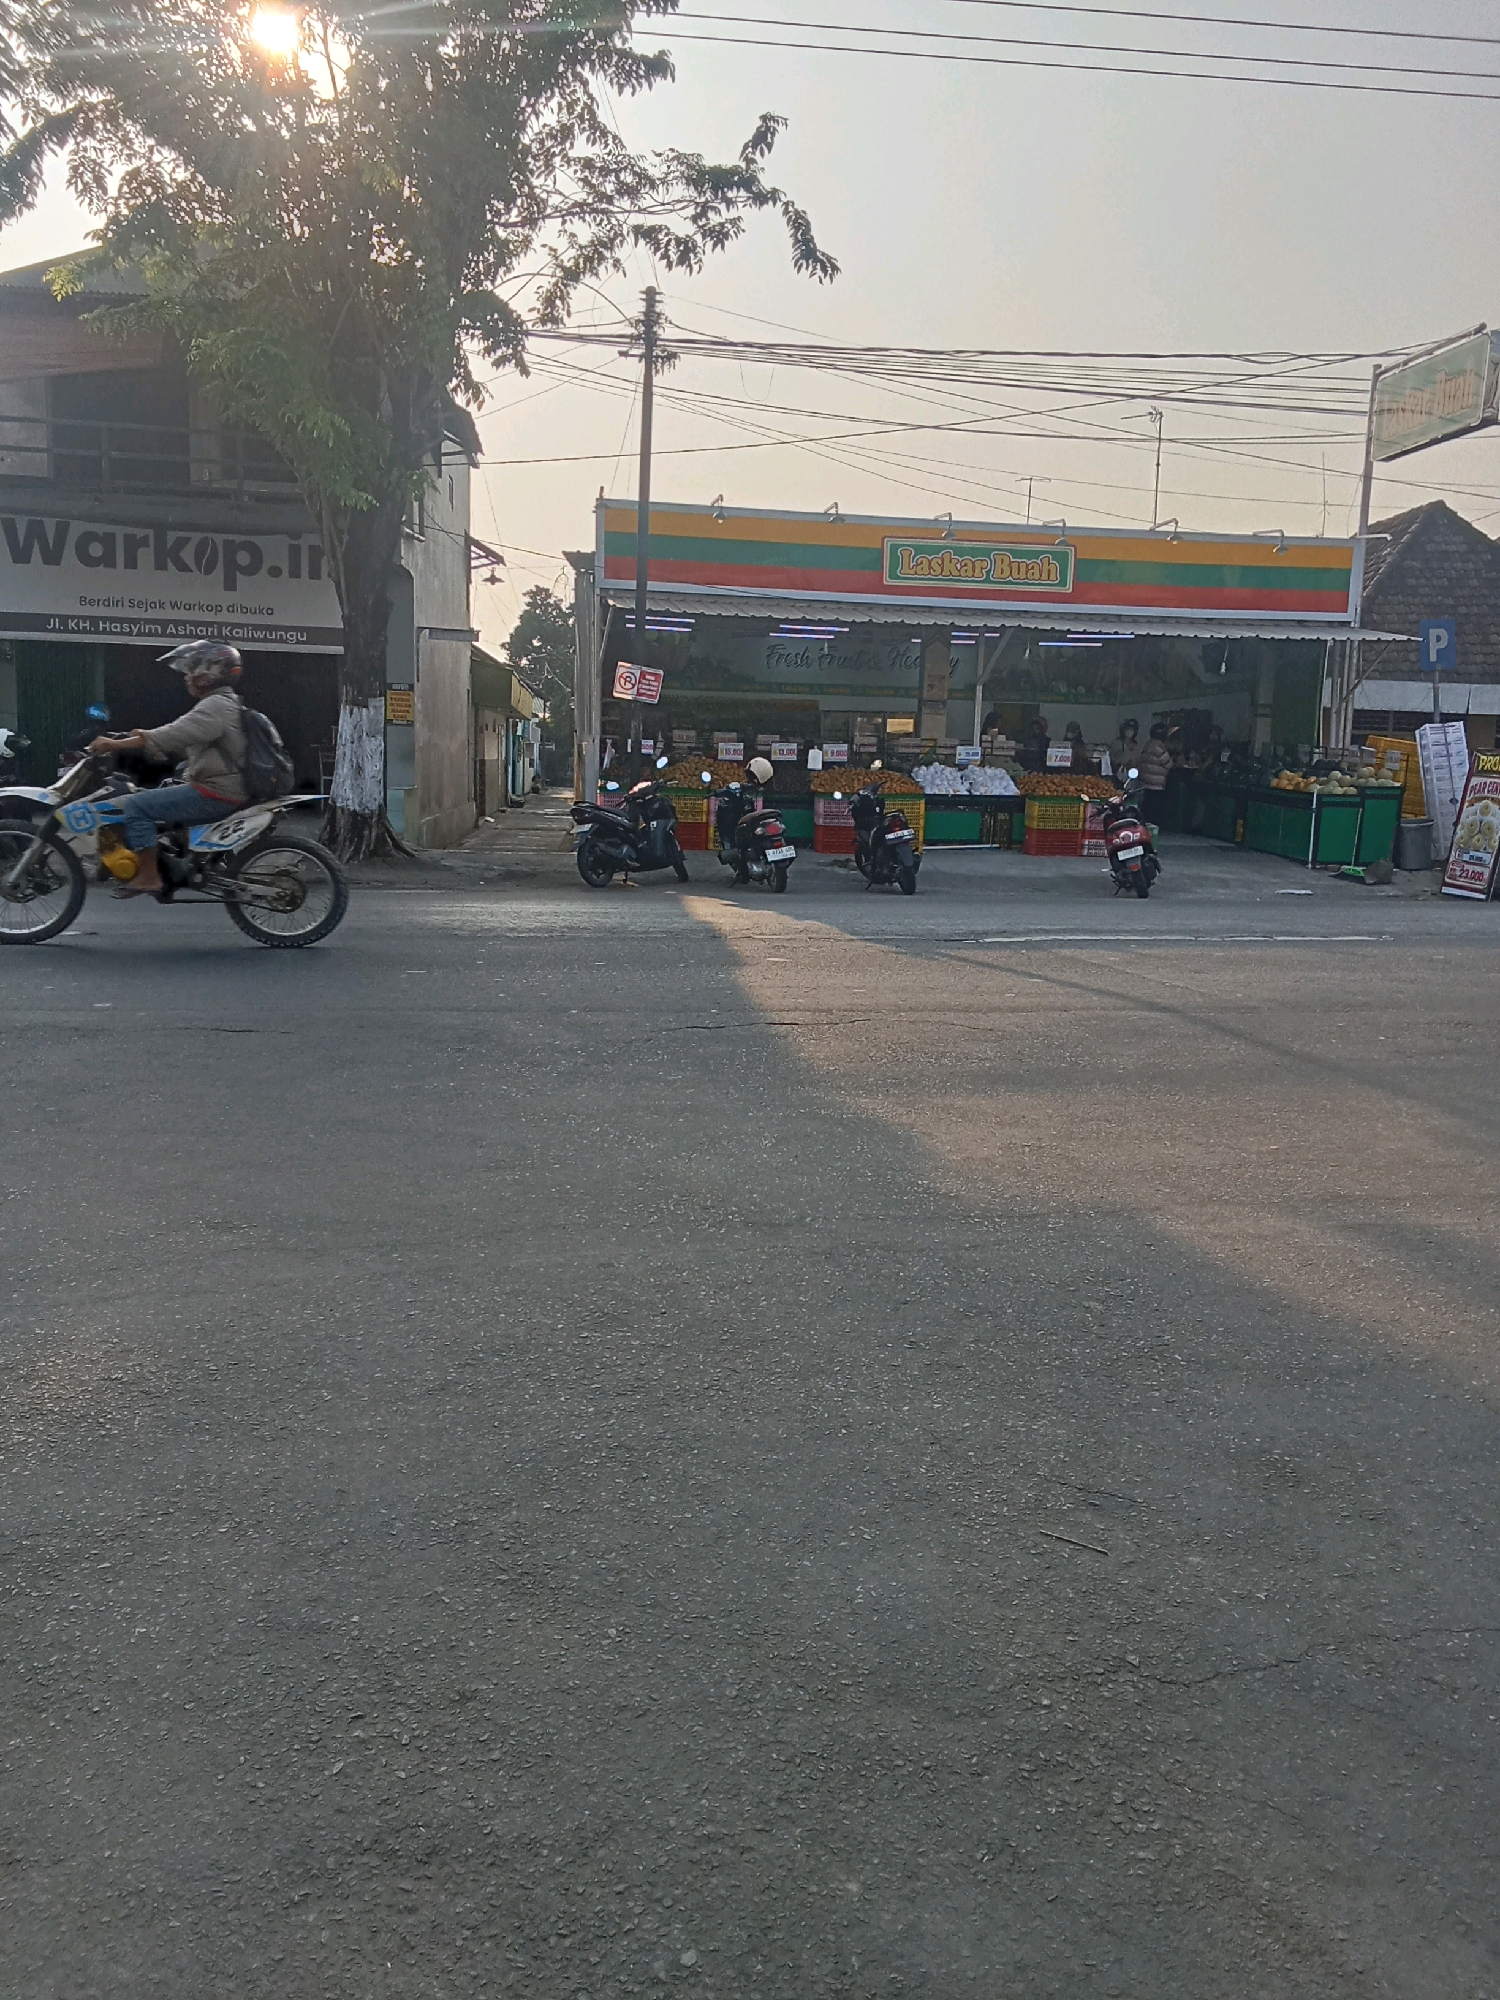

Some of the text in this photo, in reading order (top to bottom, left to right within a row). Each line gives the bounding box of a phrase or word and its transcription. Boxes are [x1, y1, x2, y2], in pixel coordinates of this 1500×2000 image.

[899, 547, 1059, 583] Laskar Buah
[79, 596, 274, 616] Berdiri Sejak Warkop dibuka
[46, 618, 307, 643] Jl. KH. Hasyim Ashari Kaliwungu
[765, 643, 812, 671] Fresh
[1429, 628, 1449, 662] P
[1468, 781, 1487, 798] PEAR
[1458, 868, 1484, 882] 23.000
